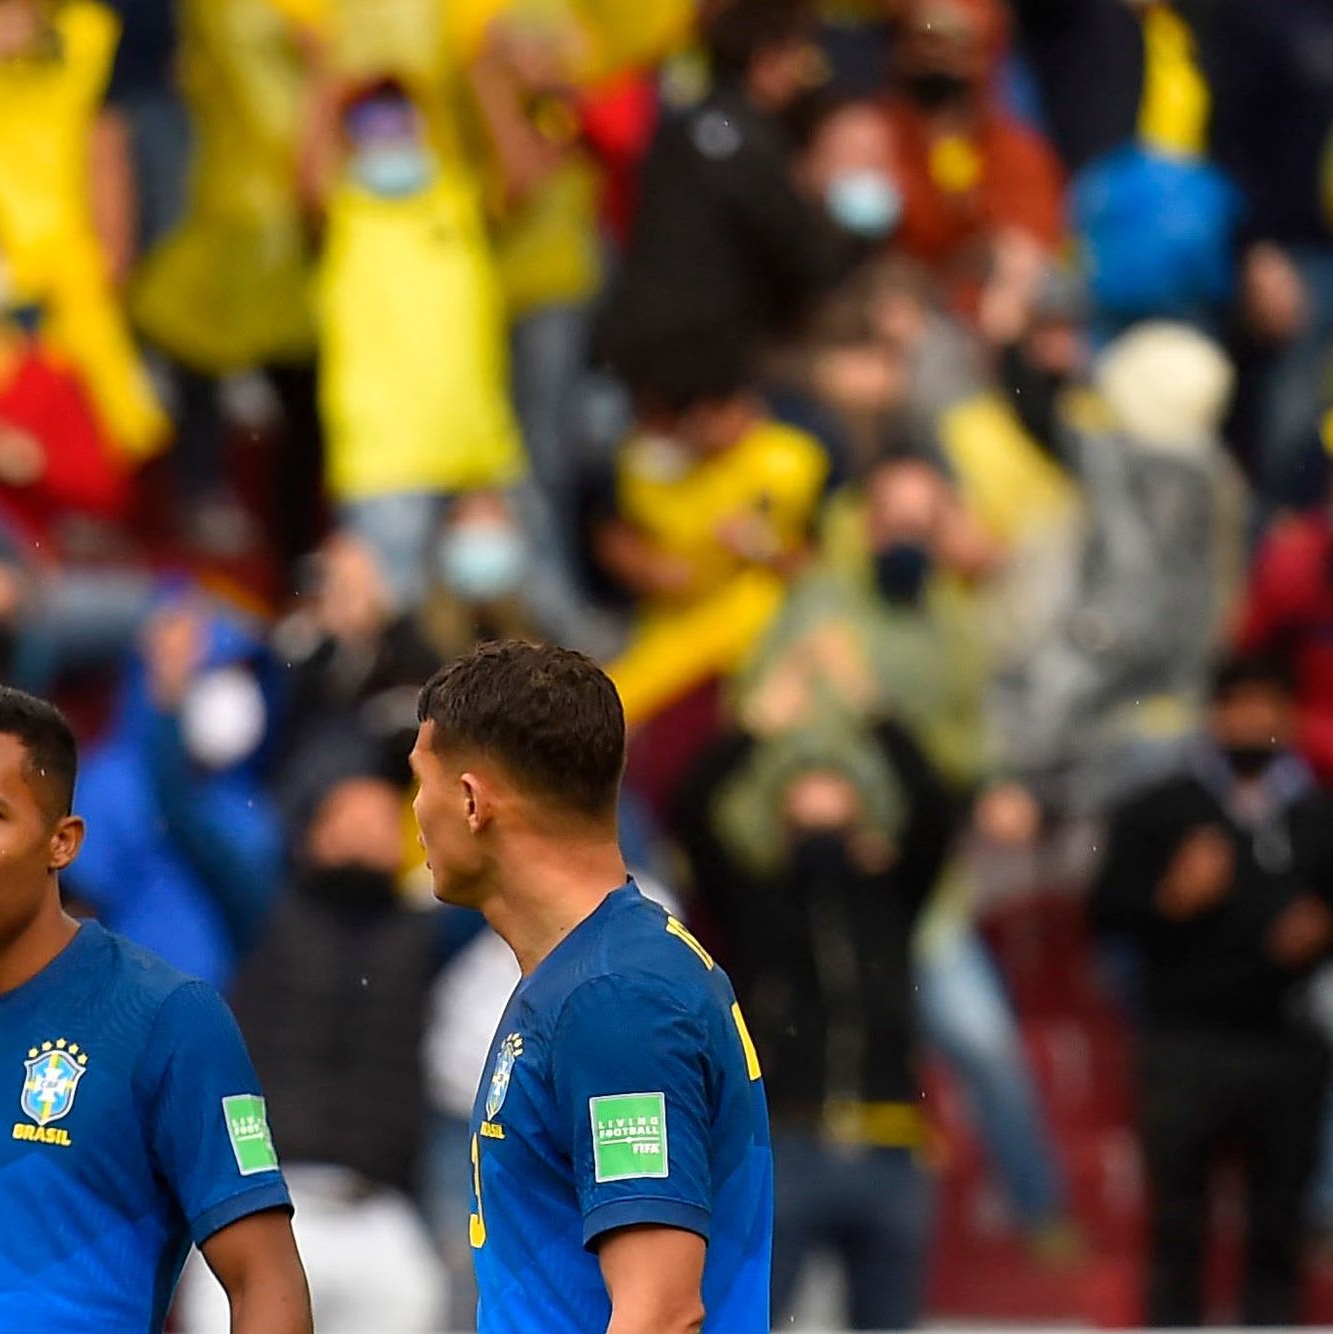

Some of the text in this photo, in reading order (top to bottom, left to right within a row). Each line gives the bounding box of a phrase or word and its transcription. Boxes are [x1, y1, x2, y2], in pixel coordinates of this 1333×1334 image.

[598, 1116, 659, 1130] LIVING
[12, 1123, 72, 1146] BRASIL
[598, 1126, 660, 1139] FOOTBALL
[632, 1143, 660, 1154] FIFA
